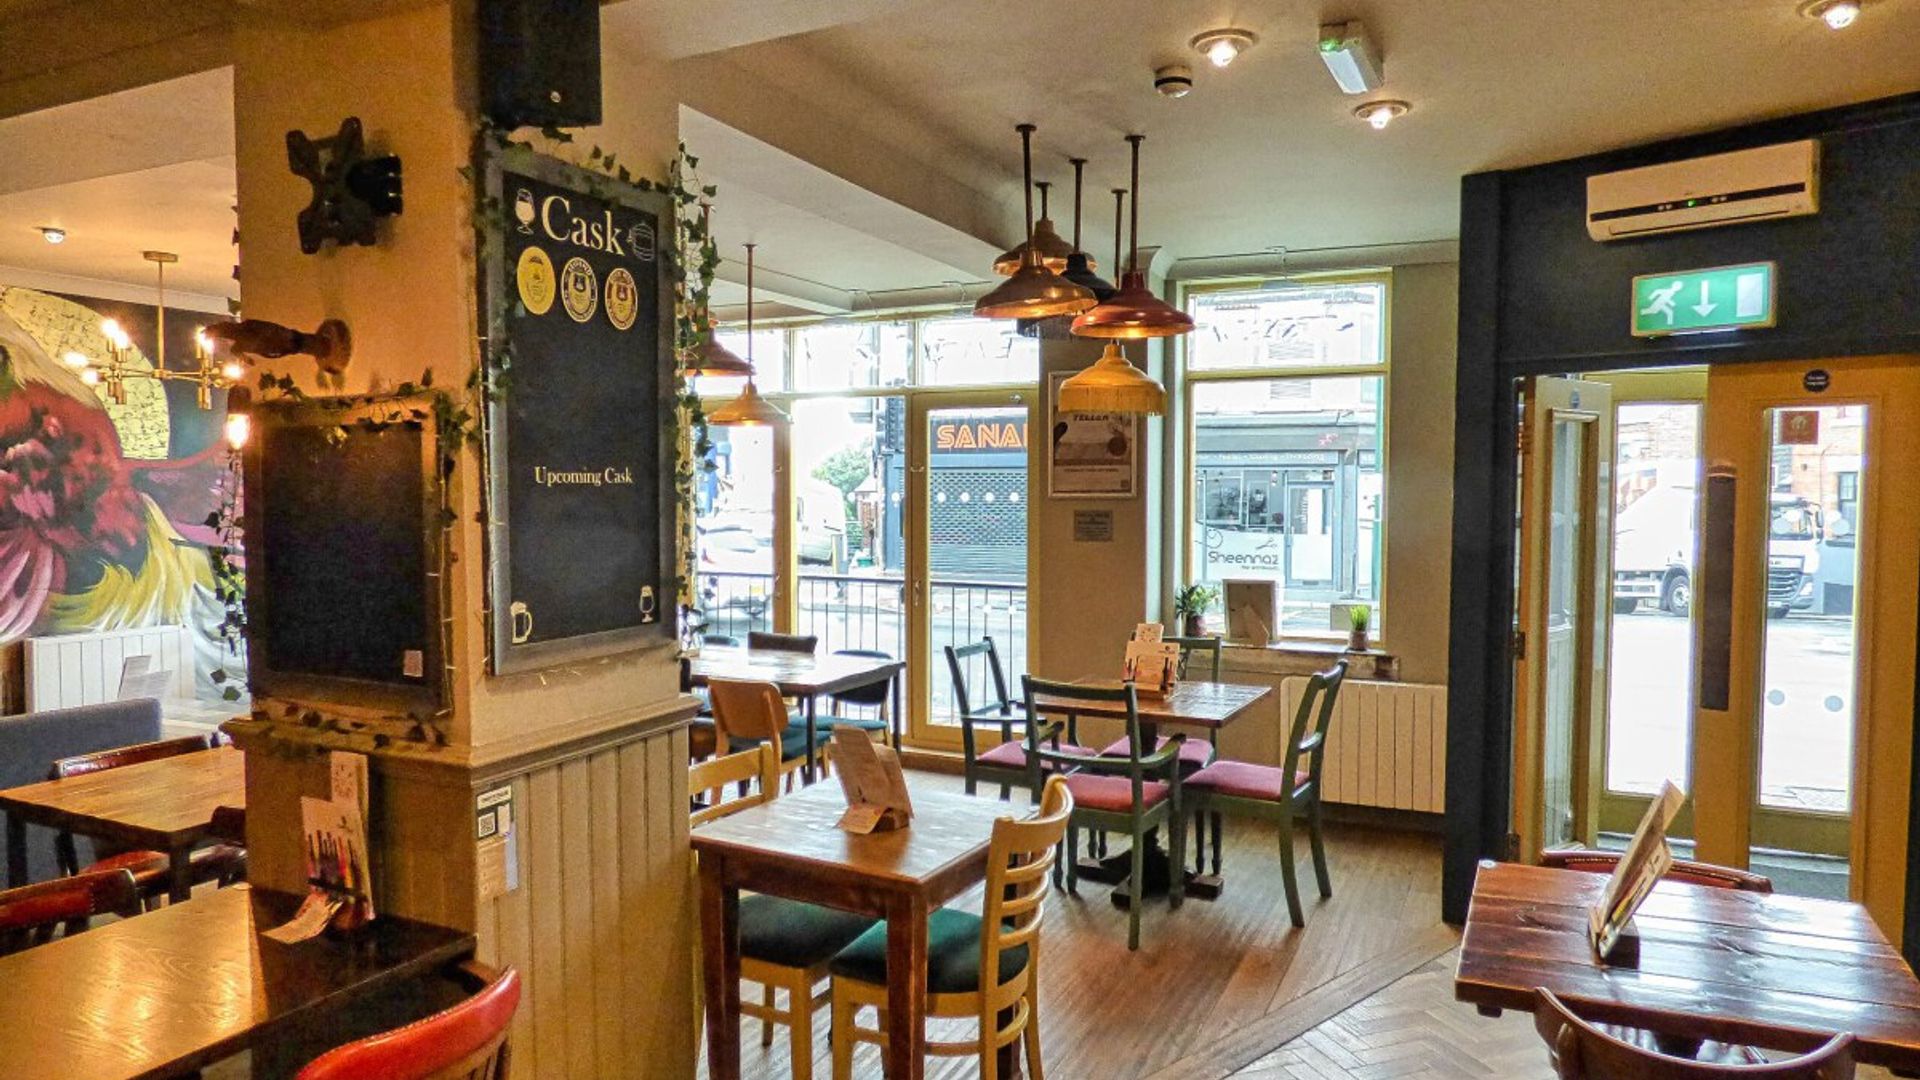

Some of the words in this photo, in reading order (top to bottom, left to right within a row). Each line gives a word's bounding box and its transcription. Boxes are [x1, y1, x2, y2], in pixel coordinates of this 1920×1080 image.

[541, 195, 626, 256] Cask
[534, 465, 602, 487] Upcoming
[604, 465, 634, 484] Cask
